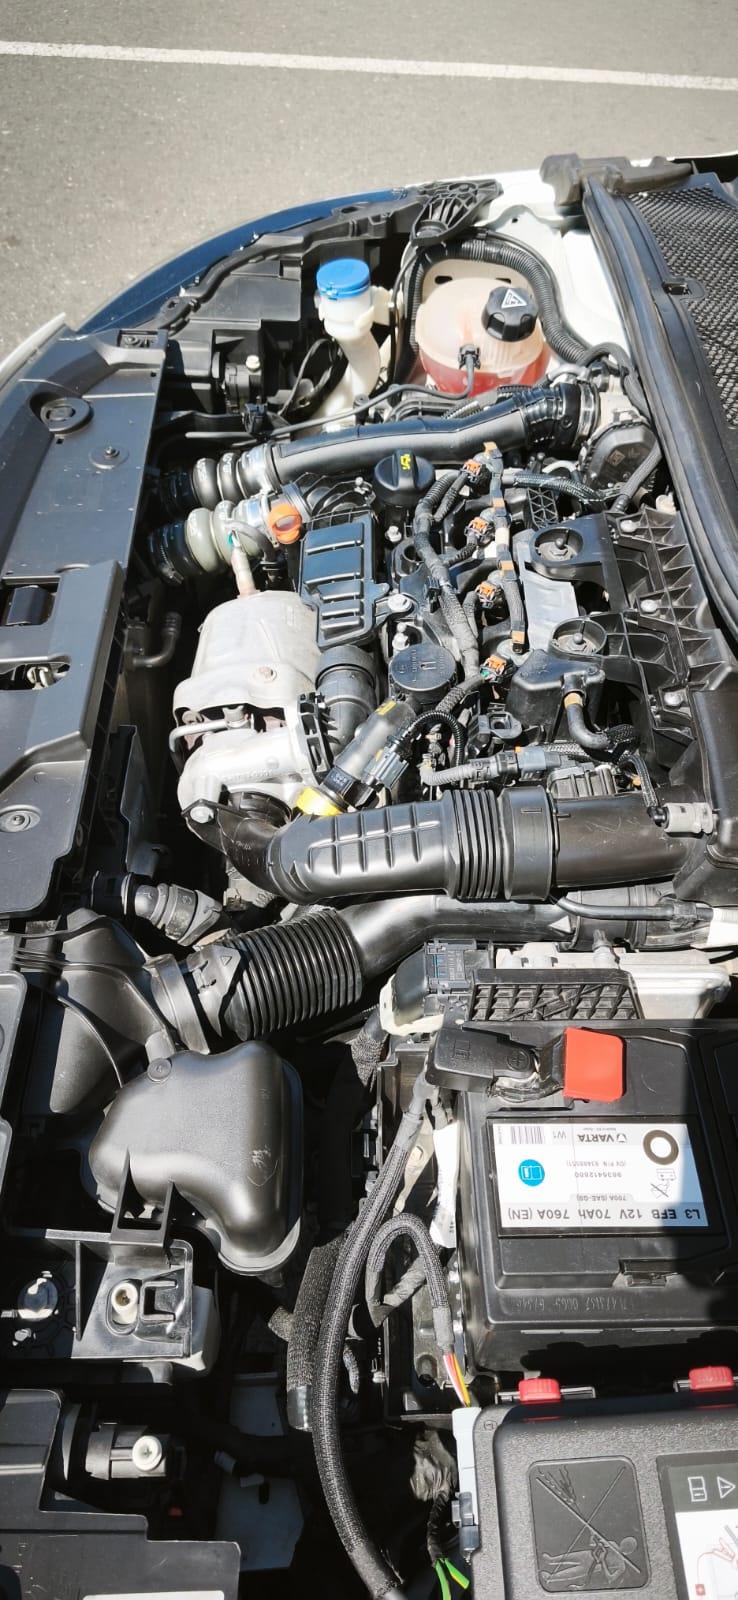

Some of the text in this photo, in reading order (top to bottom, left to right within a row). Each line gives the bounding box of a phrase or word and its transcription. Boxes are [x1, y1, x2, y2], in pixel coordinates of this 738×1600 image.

[578, 1134, 614, 1142] VARTA
[508, 1208, 700, 1220] L3 EFB 12V 70Ah 760A (EN)
